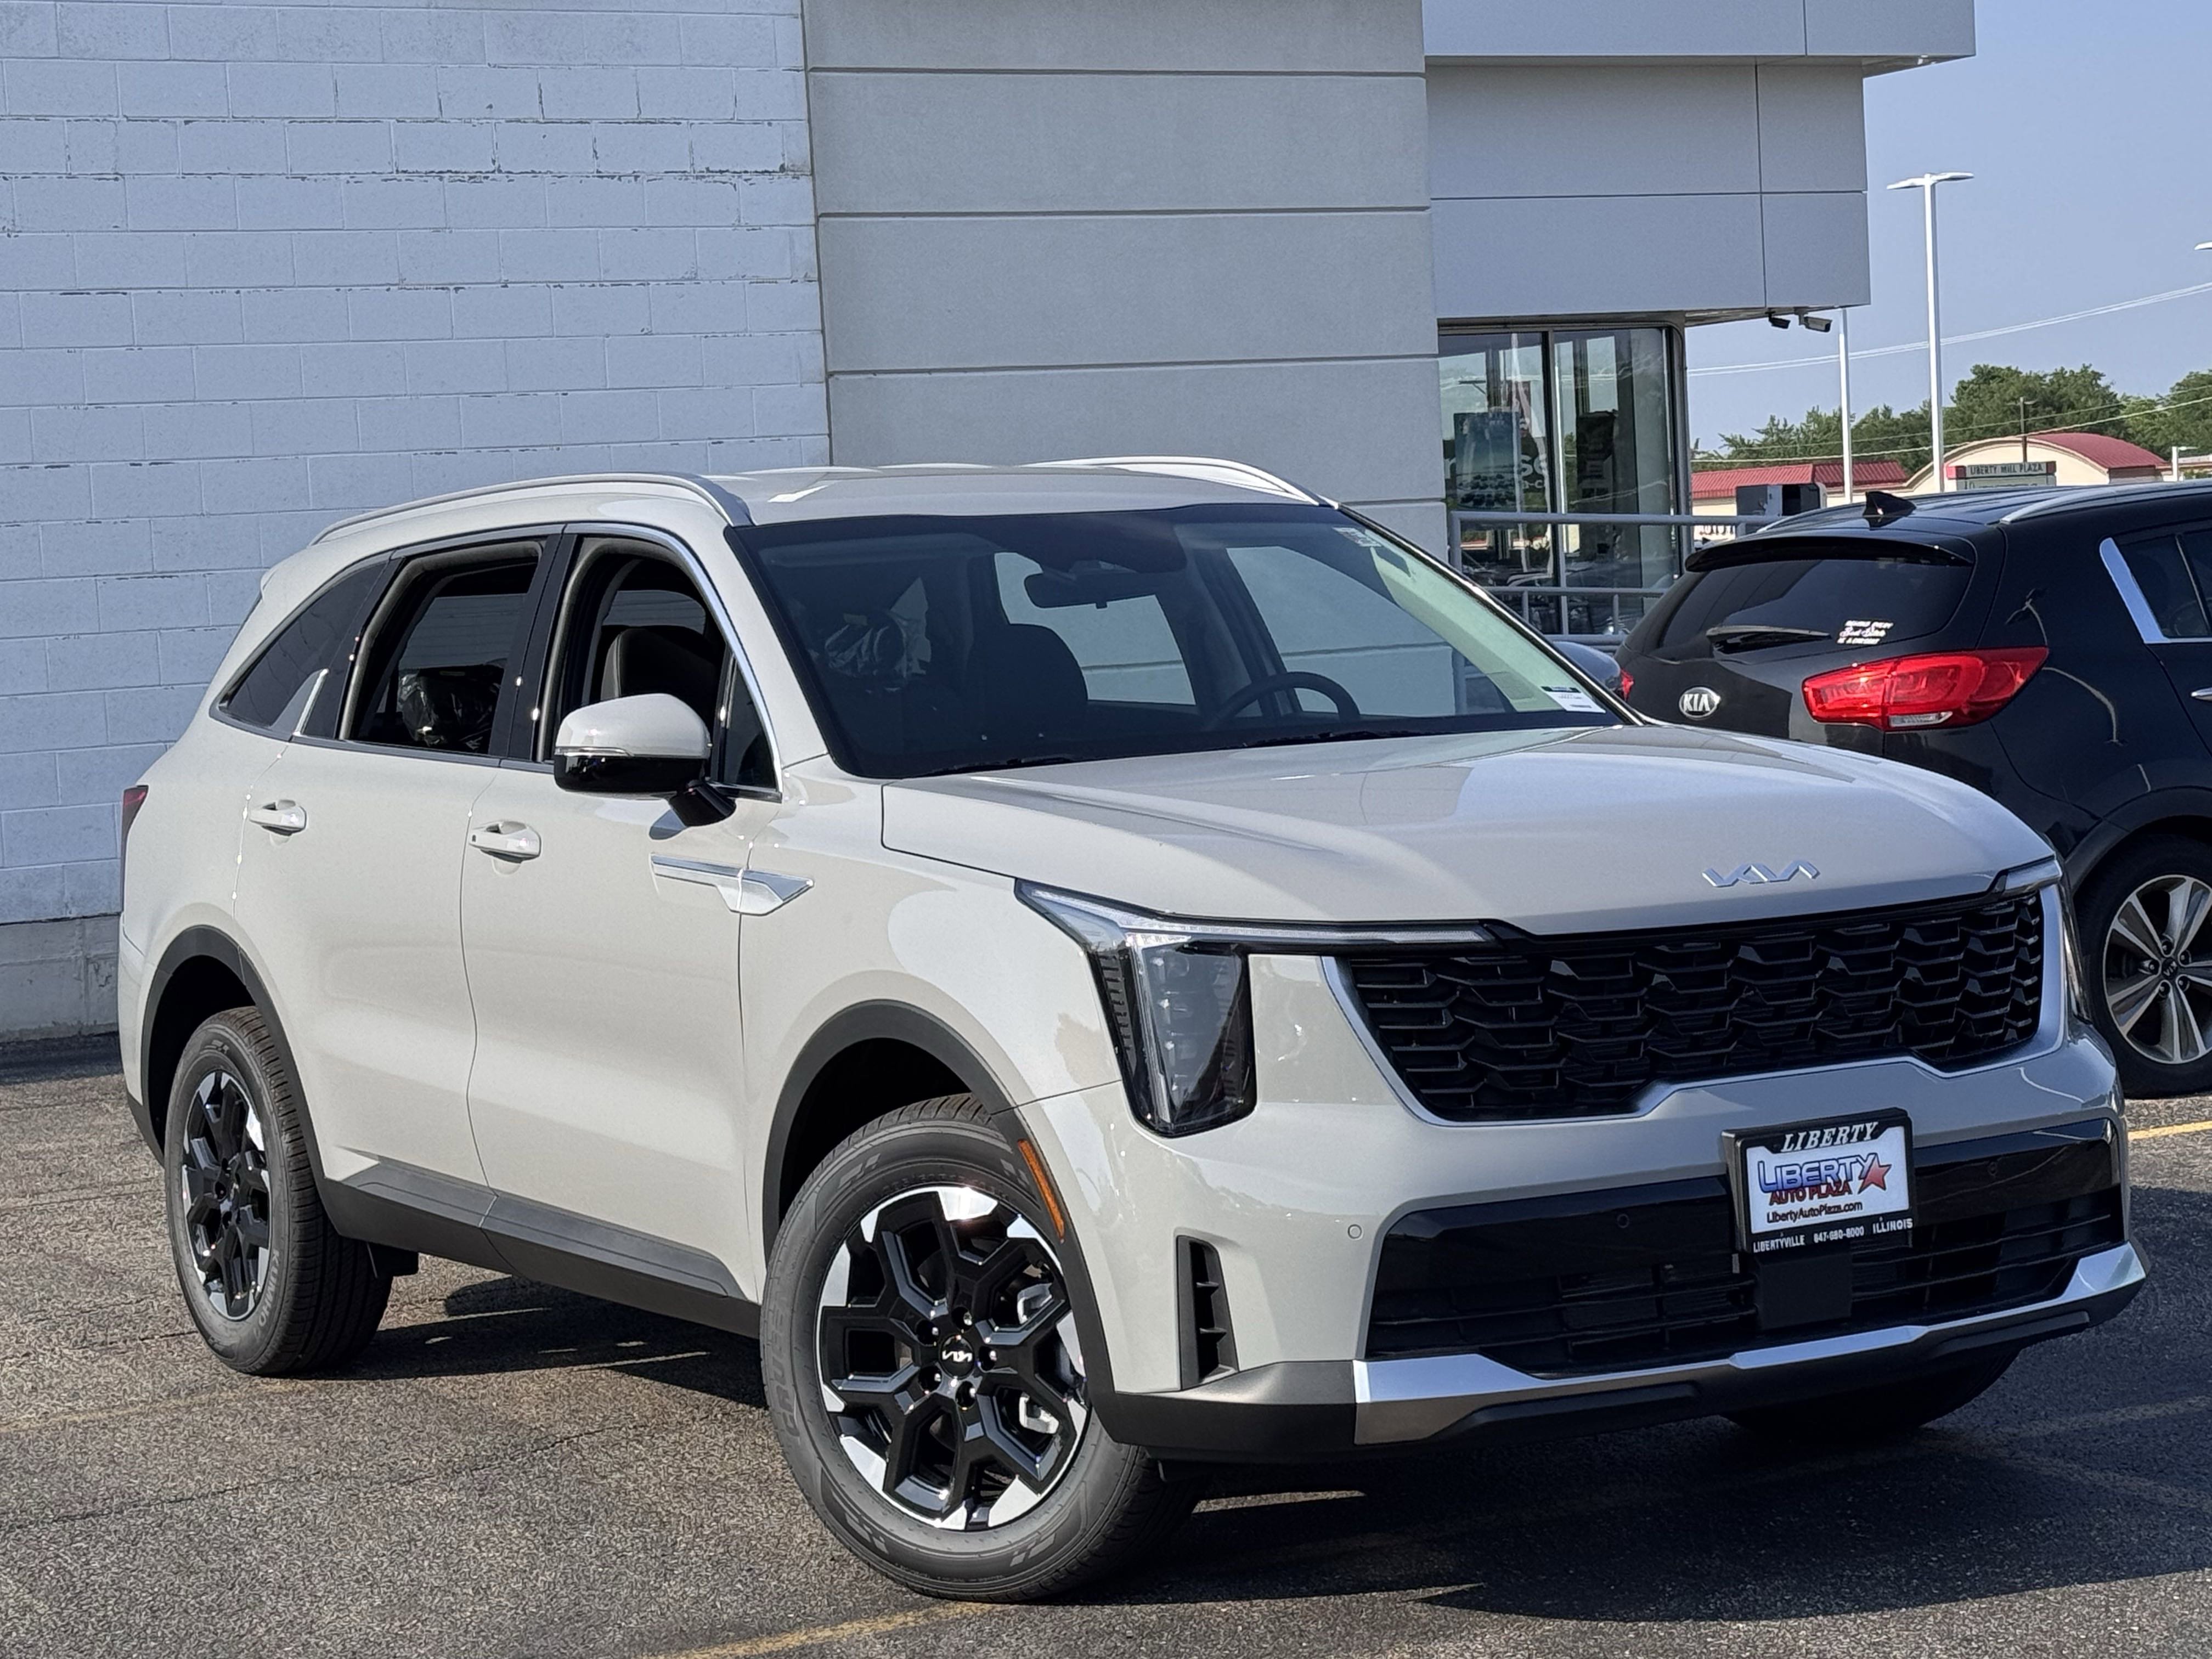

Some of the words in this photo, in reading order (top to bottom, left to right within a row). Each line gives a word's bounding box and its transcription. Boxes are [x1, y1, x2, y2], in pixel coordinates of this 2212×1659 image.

[1970, 464, 1997, 475] LIBERTY
[2001, 464, 2017, 473] MILL
[2019, 462, 2044, 472] PLAZA
[1683, 693, 1710, 712] KIA
[1781, 1122, 1878, 1152] LIBERTY
[1757, 1153, 1877, 1193] LIBERTY
[1769, 1184, 1807, 1206] AUTO
[1810, 1179, 1853, 1200] PLAZA
[1767, 1201, 1863, 1223] LibertyAutoPlaza.com
[1753, 1234, 1805, 1253] LIBERTYVILLE
[1872, 1218, 1914, 1234] ILLINOIS
[259, 1249, 280, 1327] KUMHO
